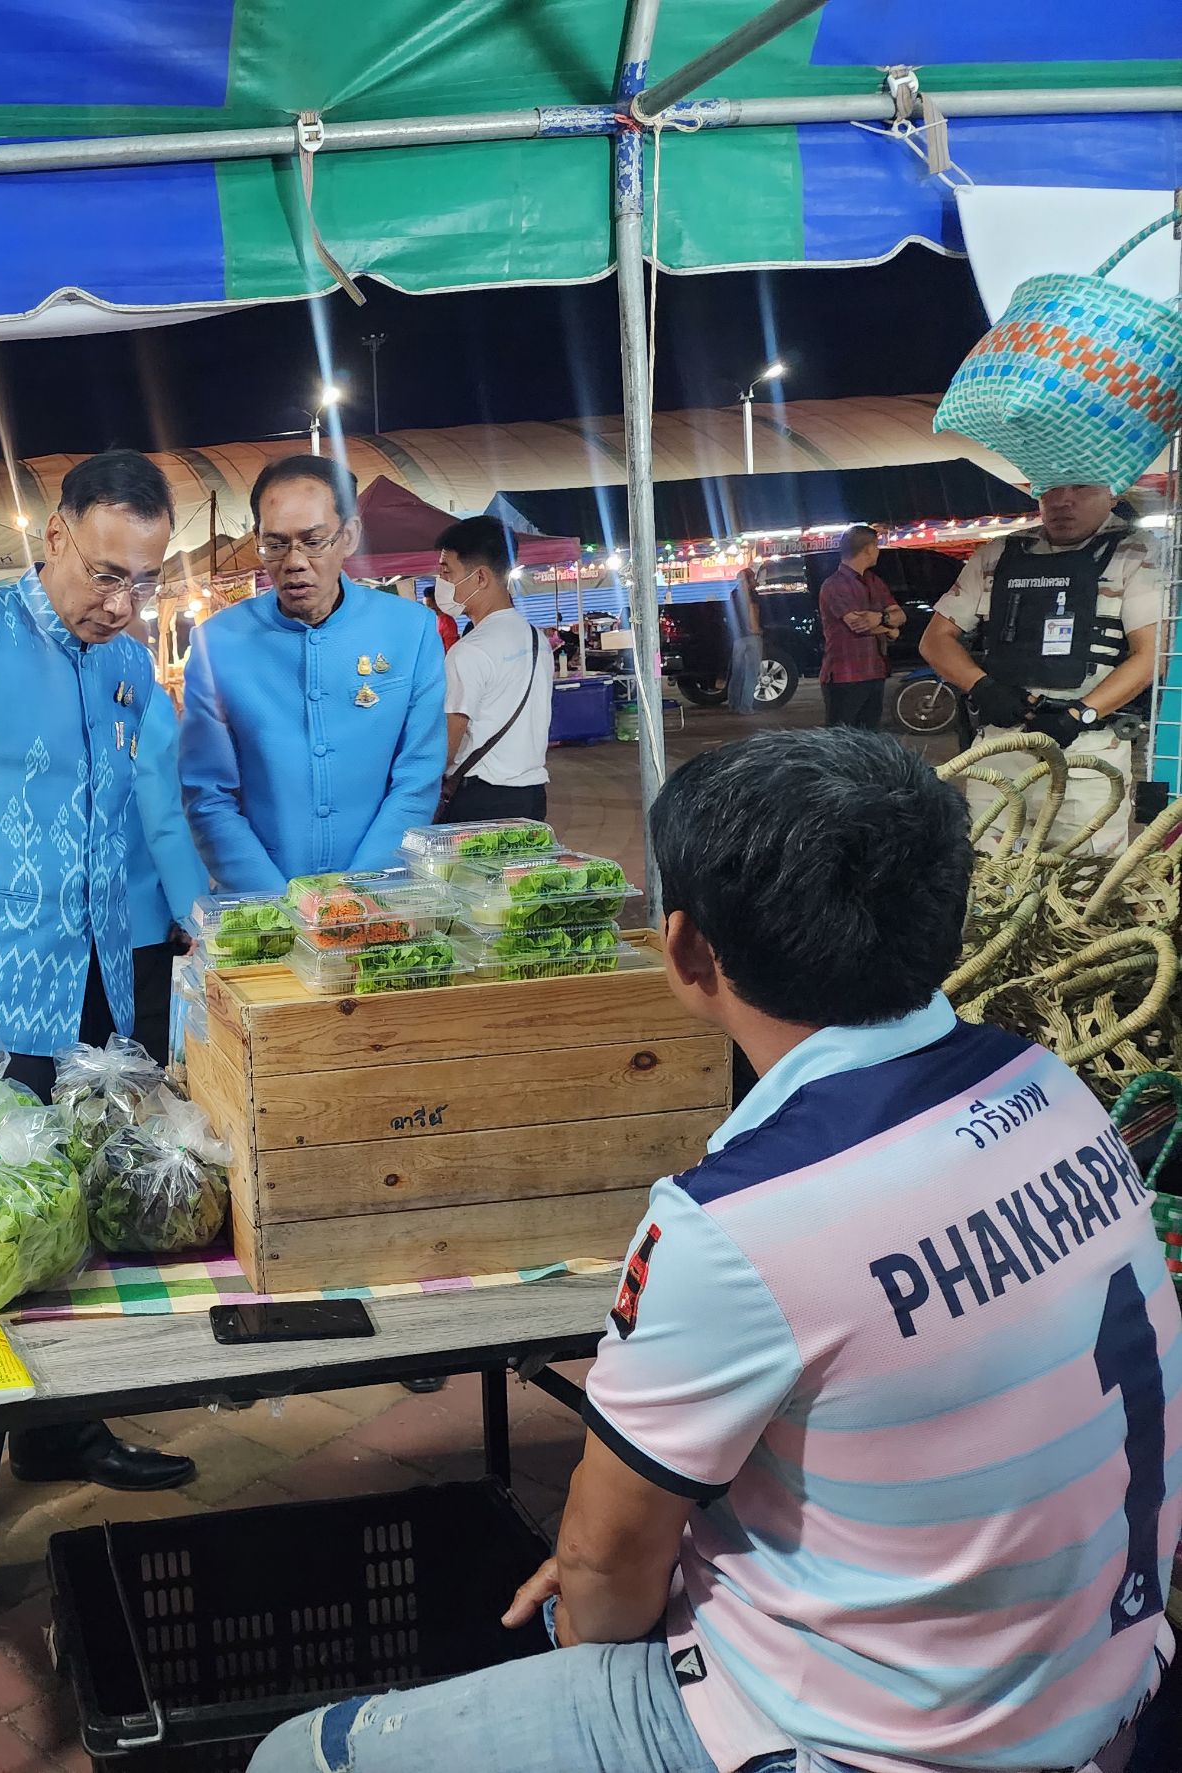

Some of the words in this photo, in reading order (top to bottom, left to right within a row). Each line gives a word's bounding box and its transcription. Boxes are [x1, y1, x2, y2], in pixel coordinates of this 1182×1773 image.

[1007, 576, 1071, 589] กรมการปกครอง
[1093, 1262, 1165, 1638] 1
